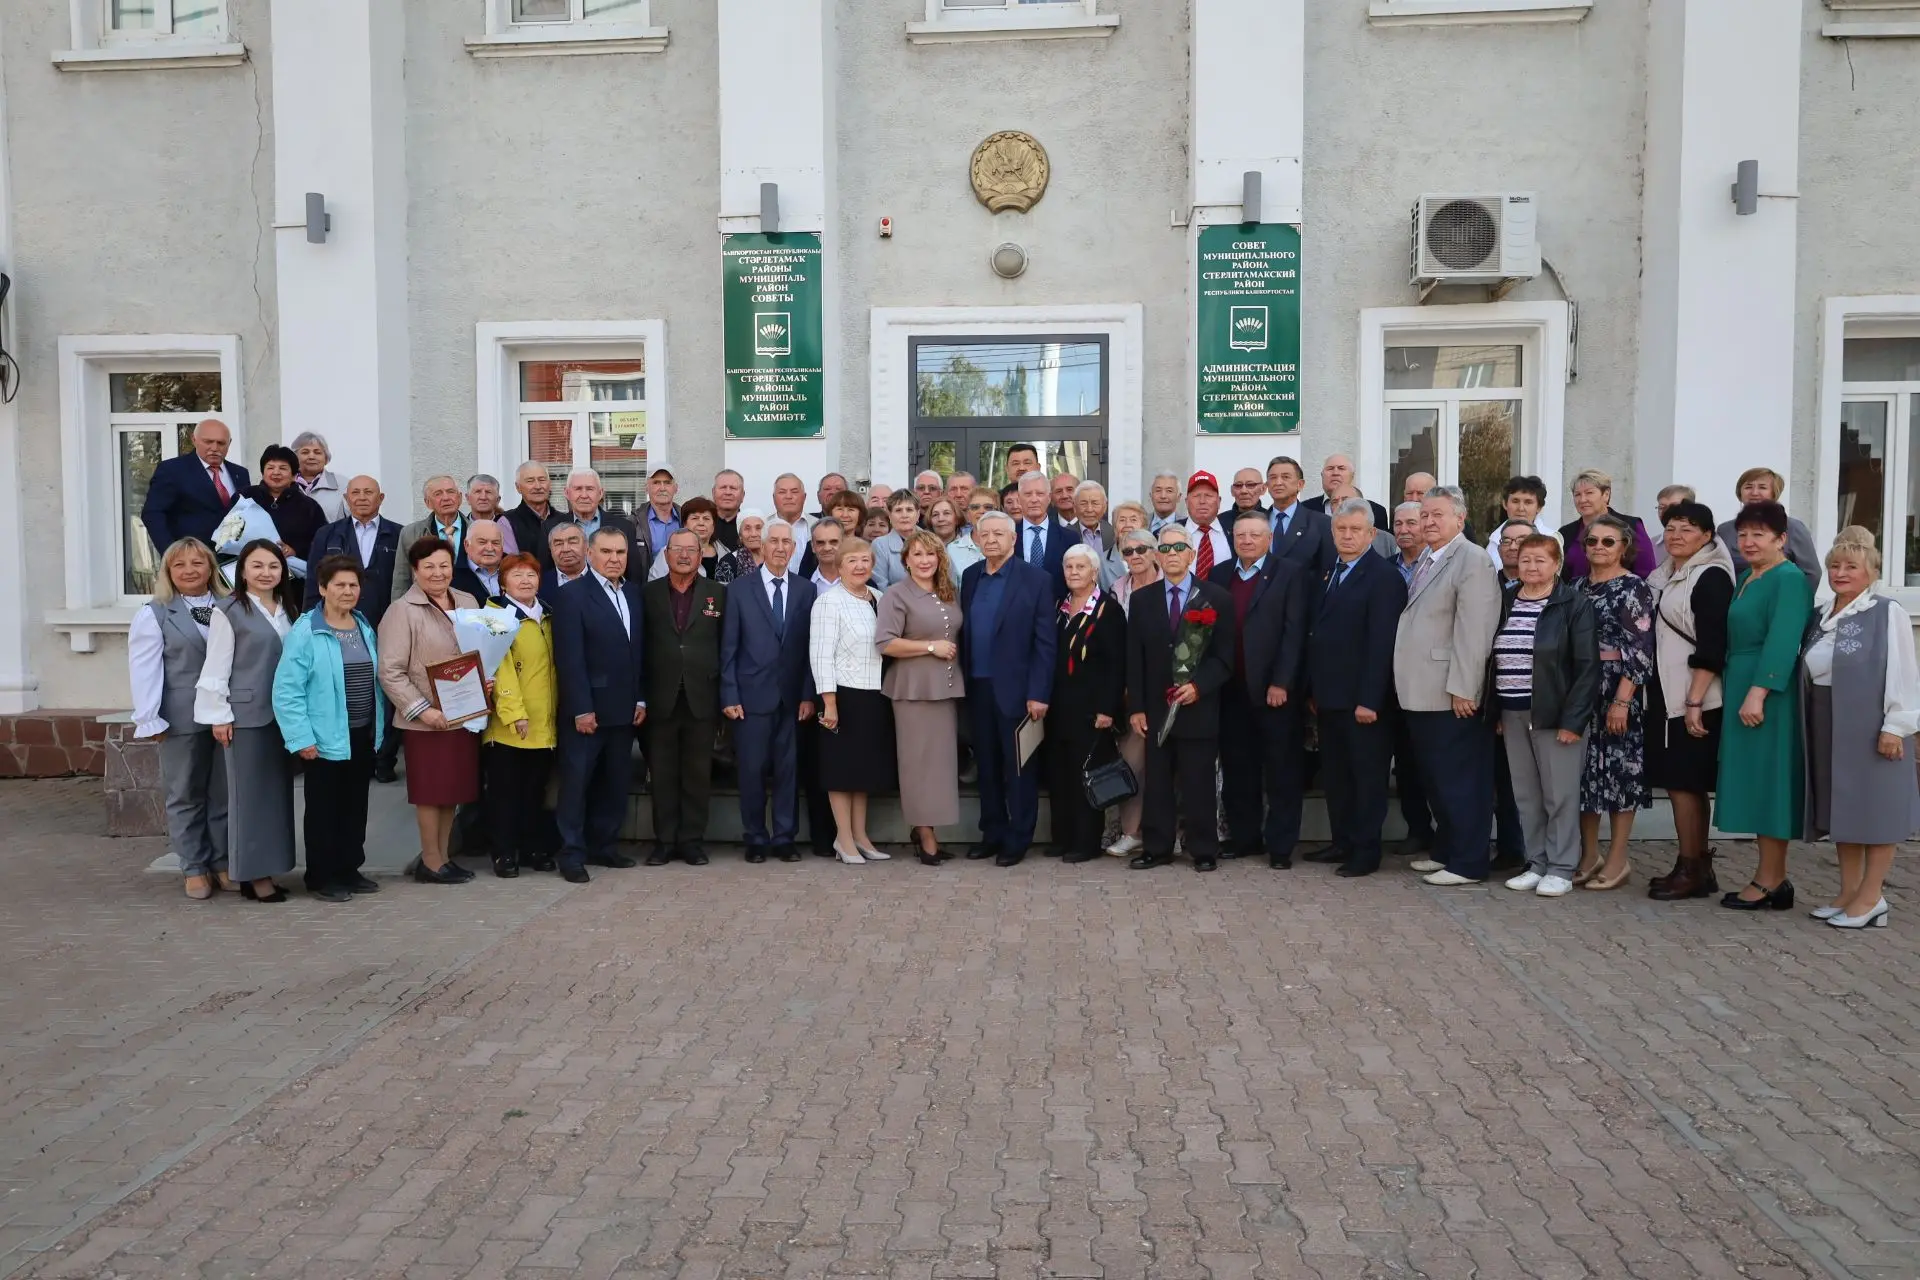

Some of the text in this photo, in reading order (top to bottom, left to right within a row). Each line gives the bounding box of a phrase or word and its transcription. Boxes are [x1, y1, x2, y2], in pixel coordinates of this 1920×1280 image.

[1231, 241, 1267, 250] СОВЕТ
[1203, 251, 1295, 260] МУНИЦИПАЛЬНОГО
[752, 264, 792, 273] РАЙОНЫ
[1232, 260, 1269, 269] РАЙОНА
[739, 274, 806, 283] МУНИЦИПАЛЬ
[1202, 269, 1296, 280] СТЕРЛИТАМАКСКИЙ
[756, 283, 788, 292] РАЙОН
[1234, 279, 1265, 288] РАЙОН
[751, 293, 794, 303] СОВЕТЫ
[1202, 363, 1295, 373] АДМИНИСТРАЦИЯ
[1203, 374, 1295, 382] МУНИЦИПАЛЬНОГО
[755, 383, 793, 392] РАЙОНЫ
[1231, 383, 1267, 392] РАЙОНА
[741, 394, 808, 402] МУНИЦИПАЛЬ
[1202, 392, 1295, 401] СТЕРЛИТАМАКСКИЙ
[759, 402, 790, 411] РАЙОН
[1233, 401, 1264, 411] РАЙОН
[743, 413, 807, 422] ХАКИМИӘТЕ
